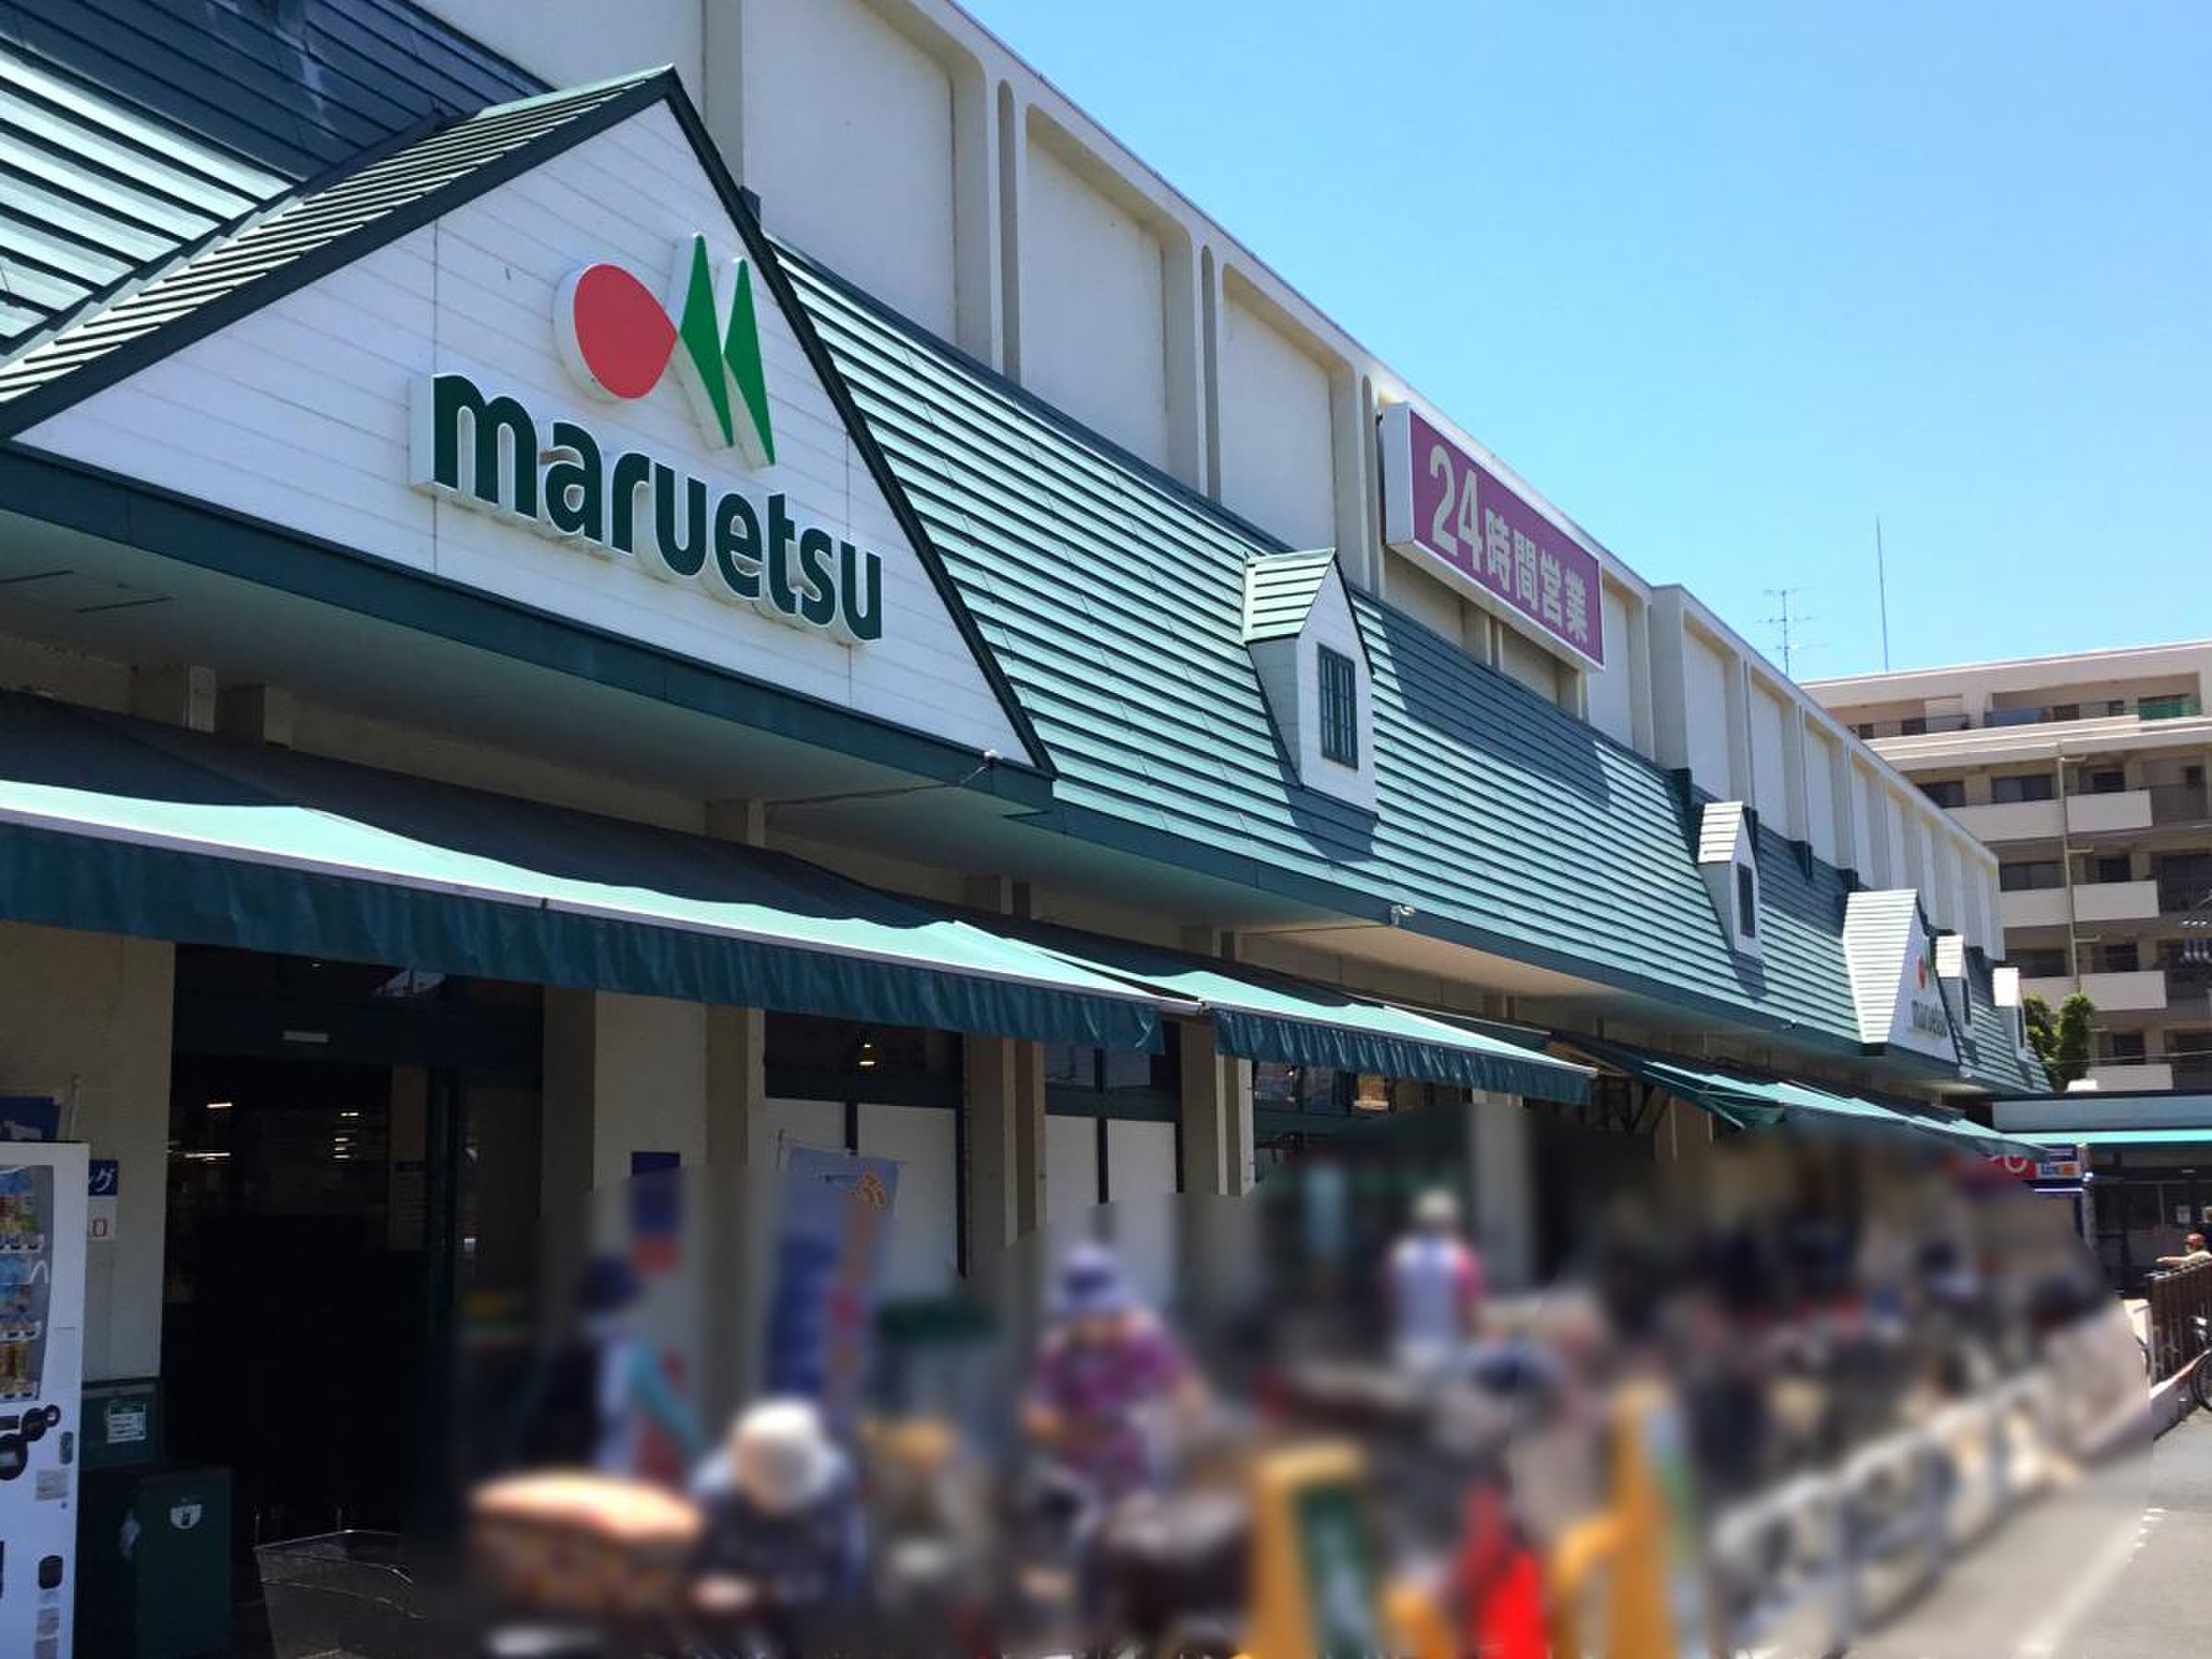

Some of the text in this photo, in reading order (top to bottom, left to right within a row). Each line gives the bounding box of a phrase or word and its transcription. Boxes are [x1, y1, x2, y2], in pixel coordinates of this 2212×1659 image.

[432, 373, 883, 641] maruetsu
[1430, 444, 1588, 643] 24時間営業
